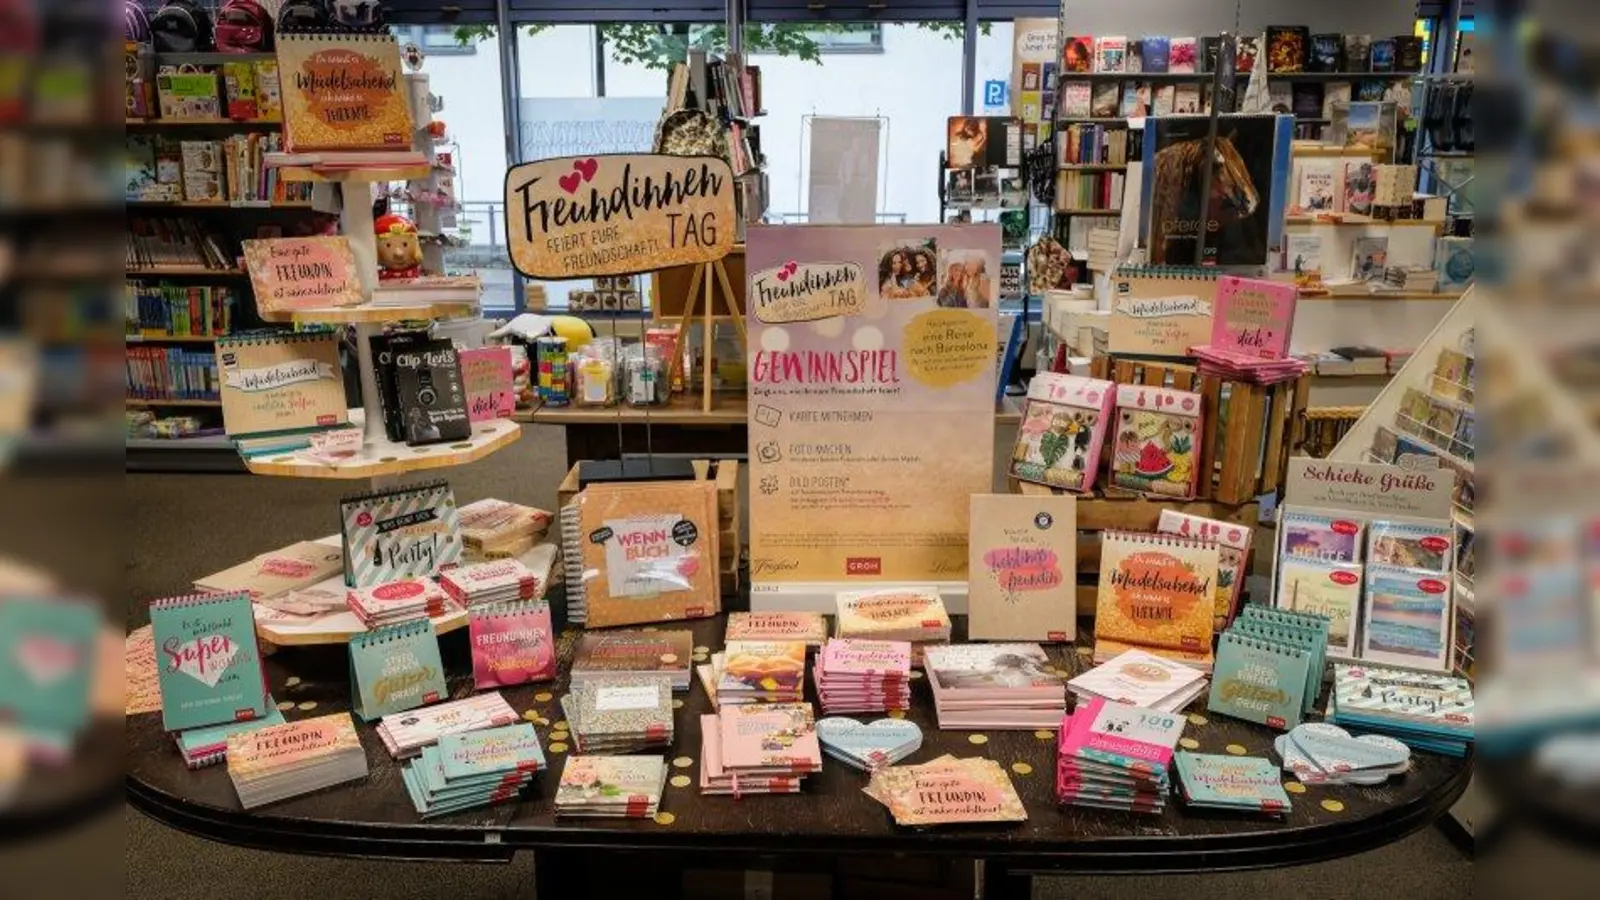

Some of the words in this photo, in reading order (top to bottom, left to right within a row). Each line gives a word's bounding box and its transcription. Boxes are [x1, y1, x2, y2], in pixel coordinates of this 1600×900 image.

[514, 163, 723, 243] Freundinnen
[546, 231, 587, 254] FEIERT
[591, 226, 621, 245] EURE
[666, 212, 717, 249] TAG
[755, 266, 857, 308] Freundinnen
[829, 287, 857, 308] TAG
[753, 349, 900, 384] GEWINNSPIEL
[625, 545, 670, 562] BUCH
[849, 561, 878, 571] GROH
[163, 636, 232, 674] Super
[919, 791, 986, 804] FREUNDIN
